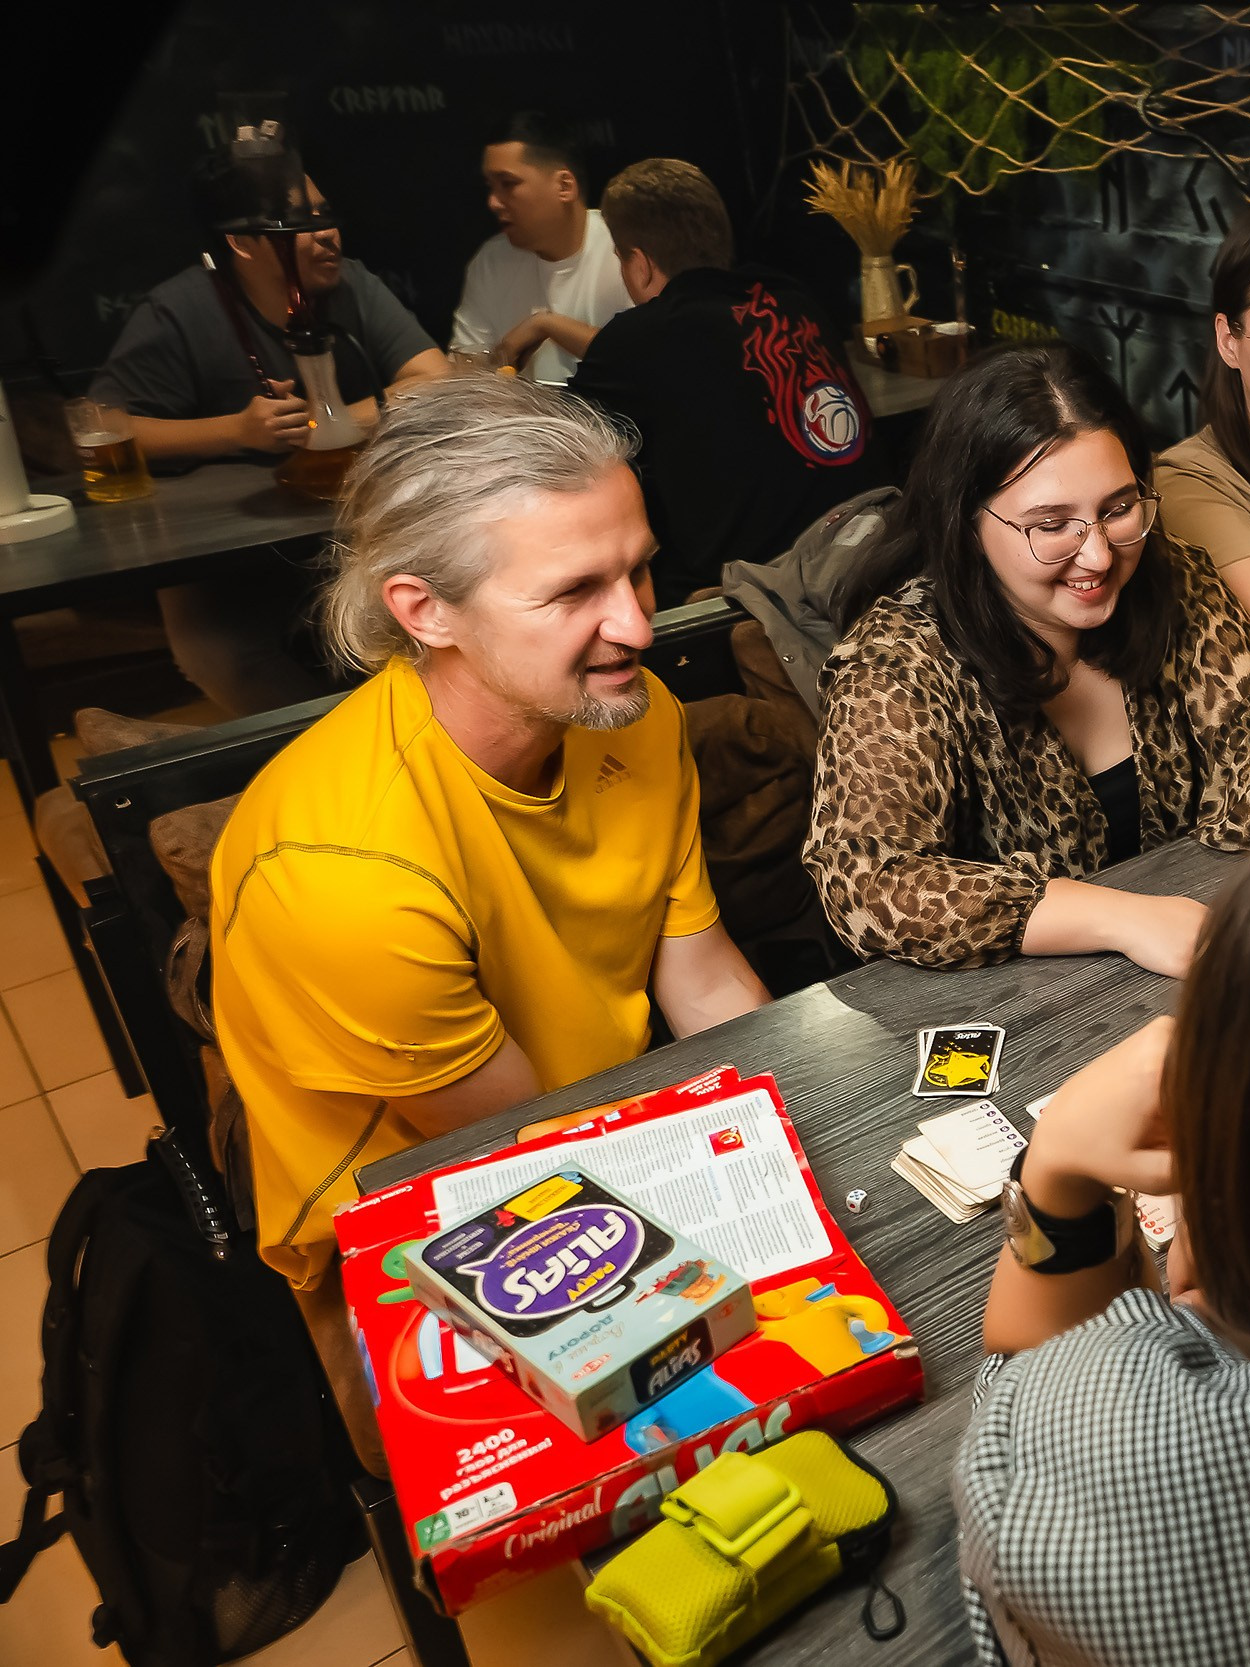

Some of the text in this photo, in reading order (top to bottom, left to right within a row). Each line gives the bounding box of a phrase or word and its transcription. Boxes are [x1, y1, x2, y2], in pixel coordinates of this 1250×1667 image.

[548, 1314, 615, 1361] ДОРОГУ
[456, 1428, 515, 1464] 2400
[504, 1485, 603, 1560] Original
